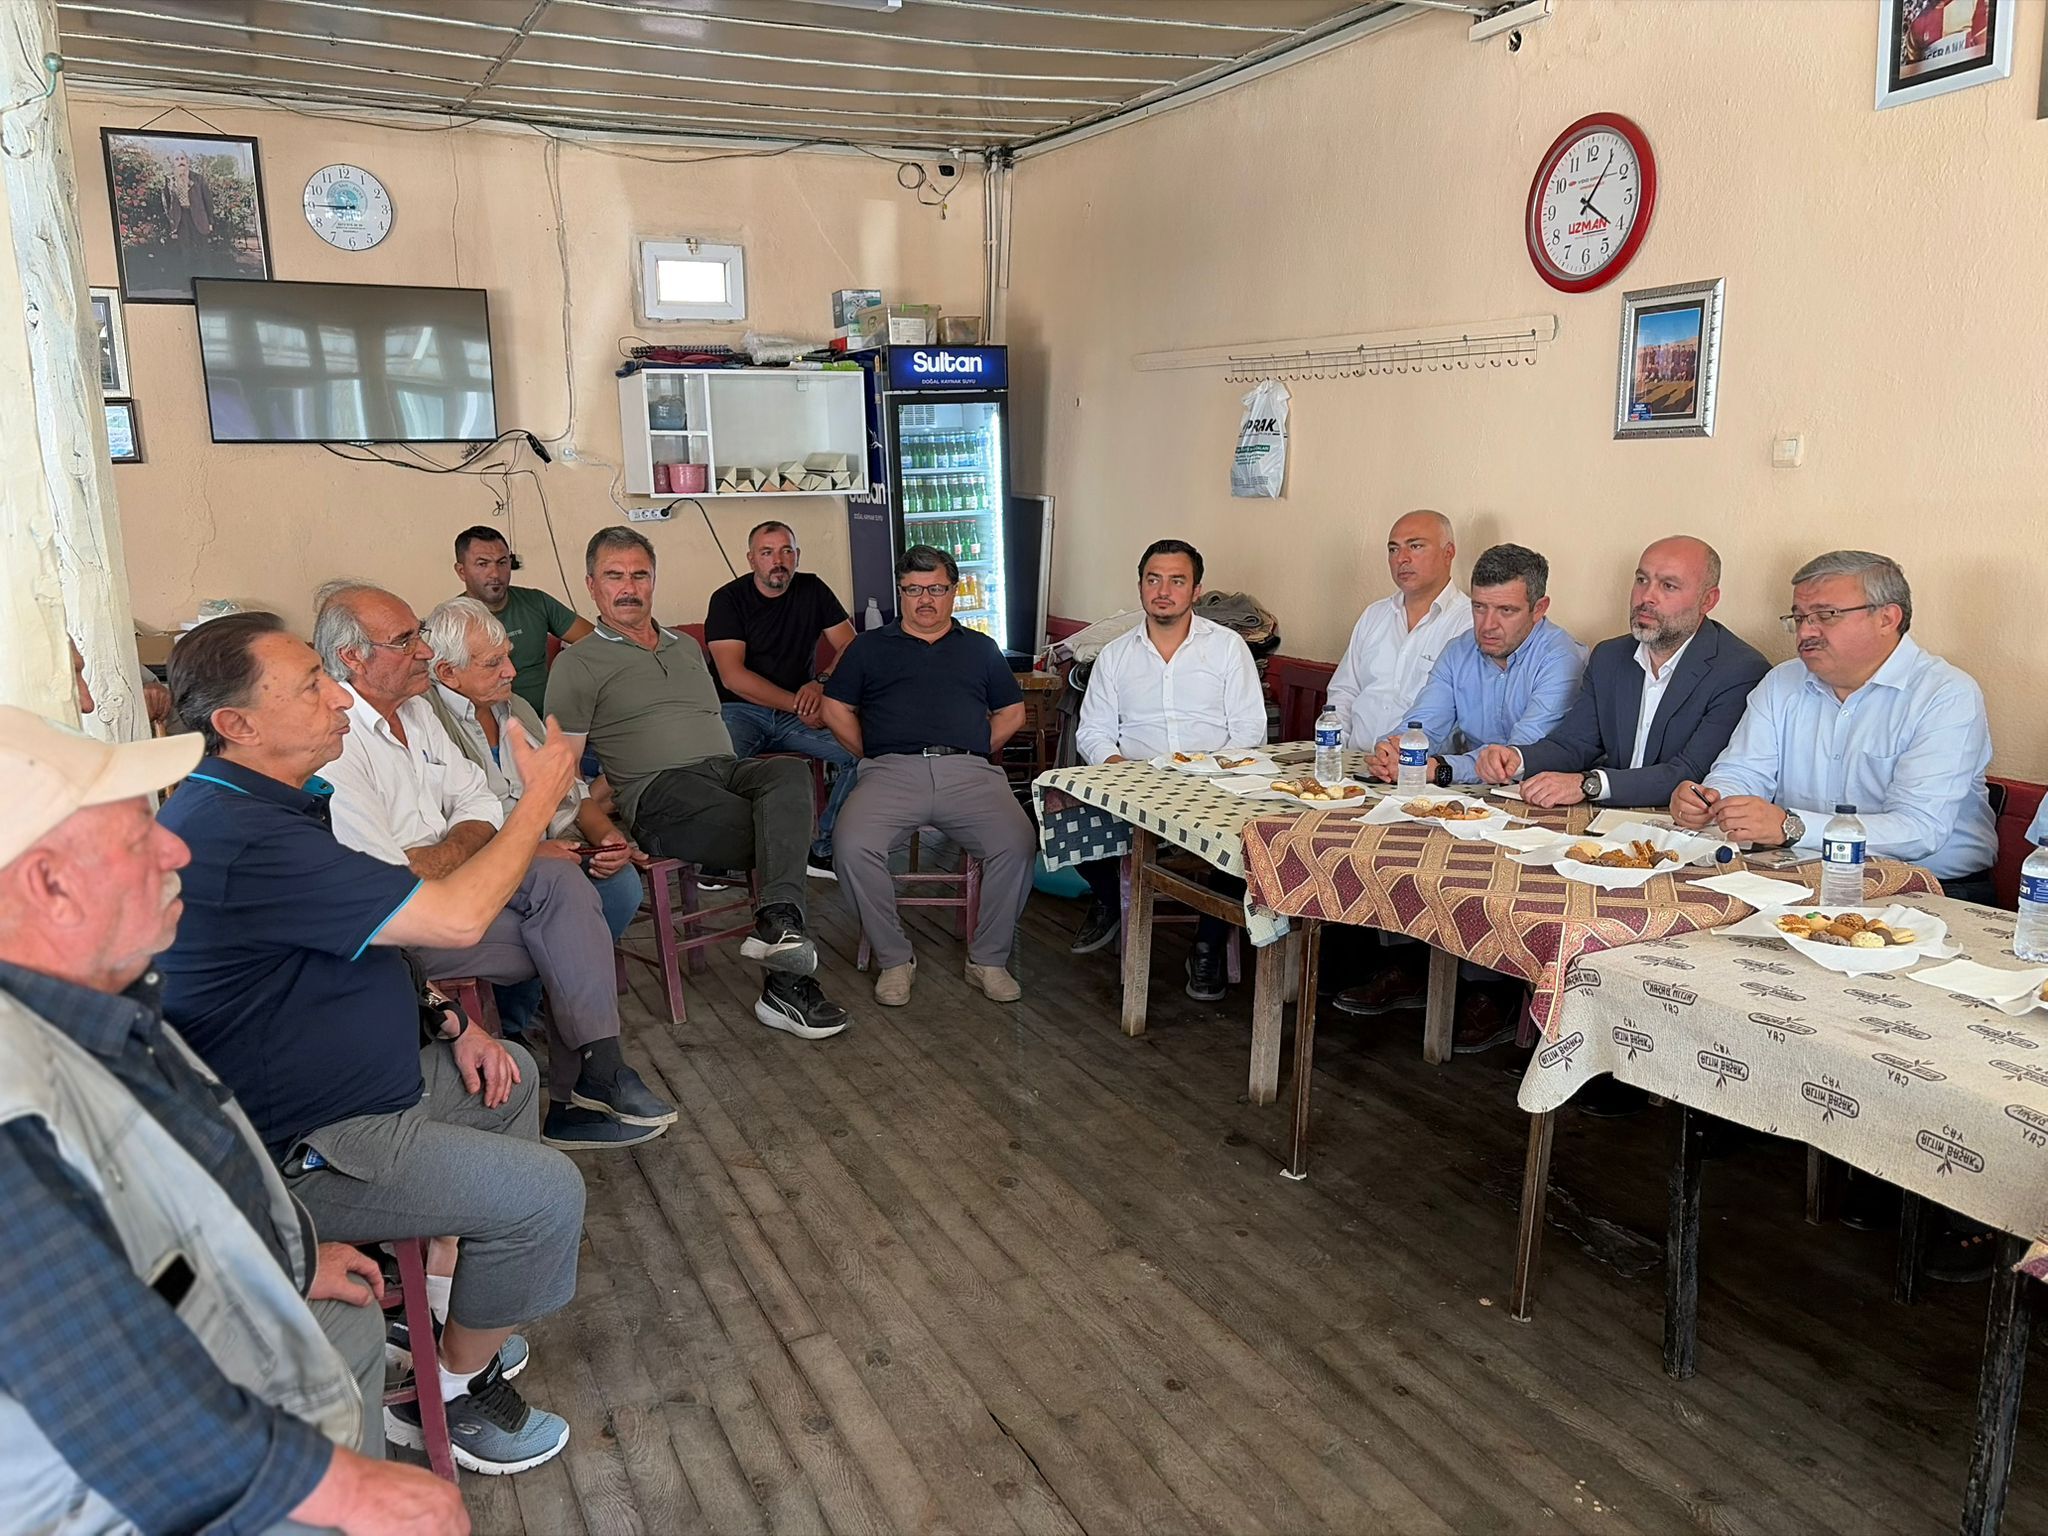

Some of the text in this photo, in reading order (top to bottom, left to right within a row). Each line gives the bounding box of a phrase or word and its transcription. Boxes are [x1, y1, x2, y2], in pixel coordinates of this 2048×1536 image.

[1587, 145, 1599, 162] 12
[1570, 157, 1580, 173] 11
[1619, 163, 1628, 181] 2
[322, 173, 331, 183] 11
[339, 168, 350, 179] 12
[361, 175, 364, 185] 1
[312, 185, 322, 195] 10
[374, 189, 380, 199] 2
[1556, 178, 1567, 194] 10
[1624, 188, 1632, 204] 3
[382, 205, 388, 214] 3
[1548, 205, 1556, 221] 9
[316, 218, 323, 227] 8
[1568, 218, 1607, 234] UZMAN
[1615, 214, 1624, 230] 4
[331, 232, 336, 242] 7
[349, 237, 356, 247] 6
[366, 233, 373, 244] 5
[1552, 229, 1560, 245] 8
[1564, 244, 1572, 260] 7
[1600, 237, 1610, 254] 5
[1581, 248, 1590, 264] 6
[913, 351, 983, 373] Sultan
